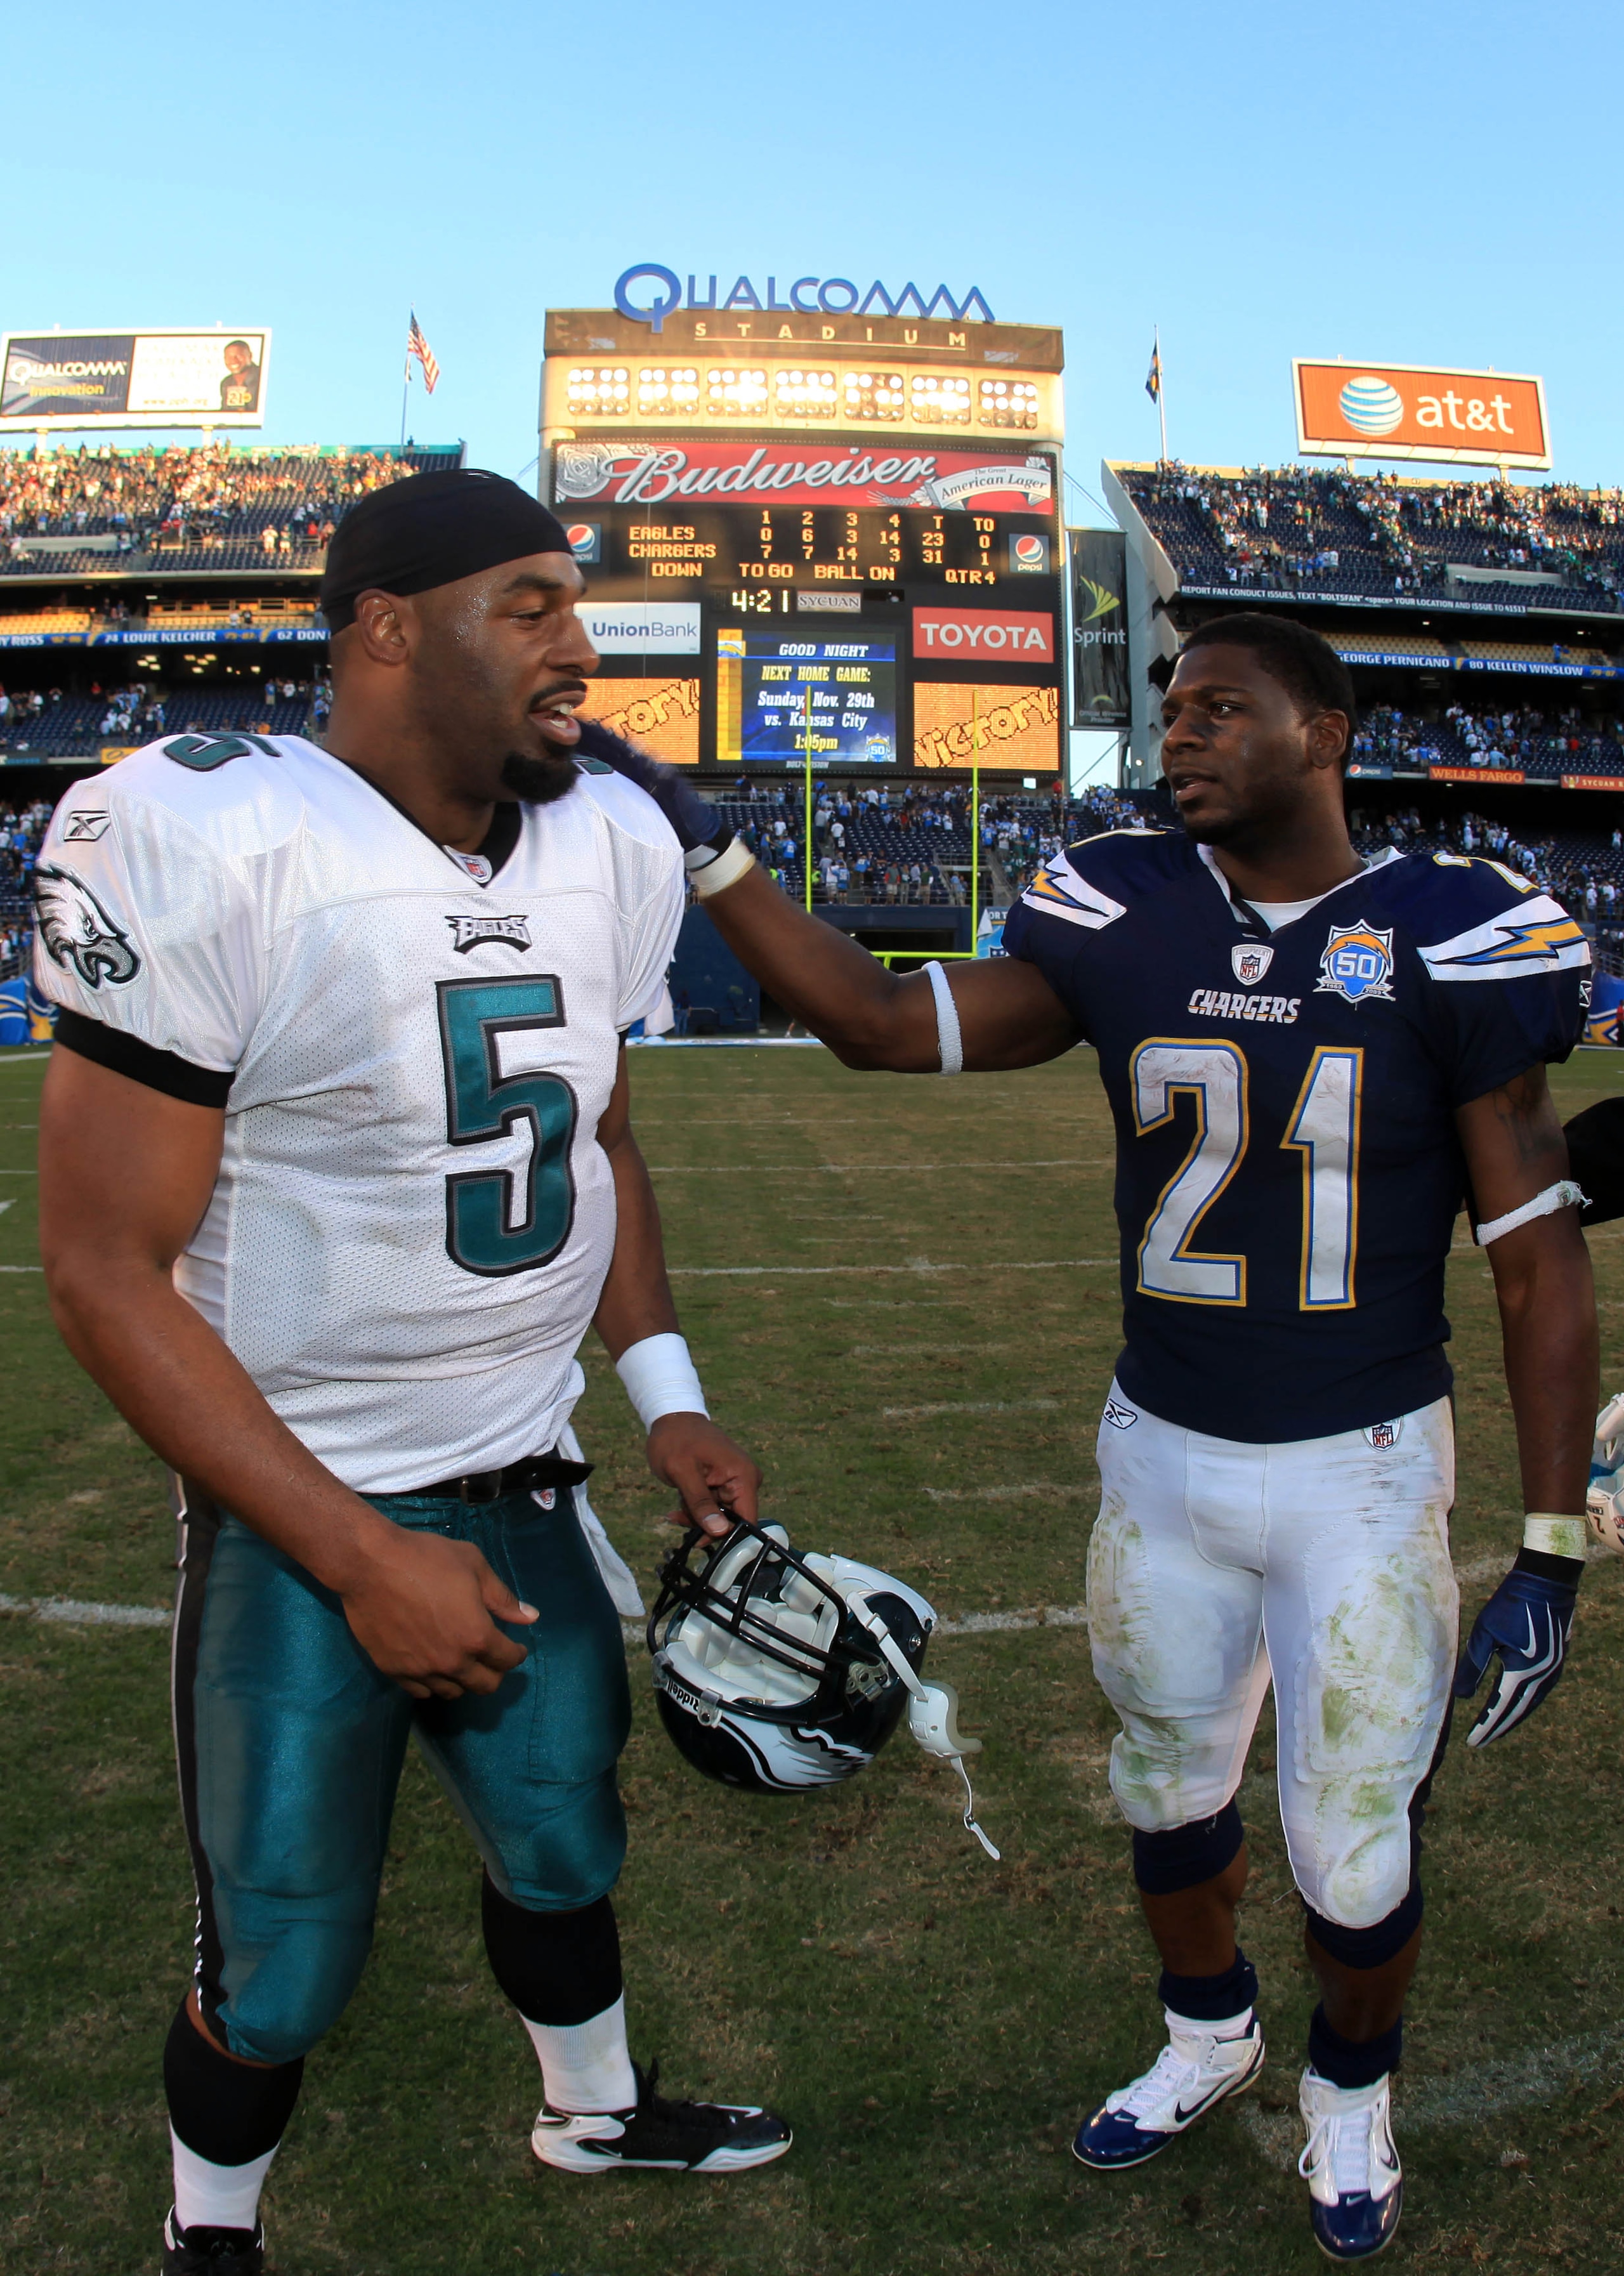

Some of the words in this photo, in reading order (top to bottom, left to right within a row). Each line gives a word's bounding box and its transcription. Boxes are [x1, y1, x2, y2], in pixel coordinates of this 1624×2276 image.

[614, 263, 995, 333] QUALCOMM
[694, 322, 966, 347] STADIUM
[9, 360, 126, 386] QUALCOMM
[30, 383, 104, 397] Innovation
[1415, 390, 1514, 435] at&t
[602, 447, 937, 503] Budweiser
[941, 476, 1004, 500] American
[1007, 473, 1047, 489] Lager
[763, 510, 770, 524] 1
[802, 511, 813, 525] 2
[847, 513, 858, 526] 3
[889, 514, 900, 528] 4
[933, 516, 944, 530] T
[973, 517, 995, 532] TO
[629, 526, 695, 540] EAGLES
[761, 528, 772, 542] 0
[802, 528, 813, 542] 6
[847, 529, 858, 543] 3
[880, 531, 900, 545] 14
[922, 532, 944, 546] 23
[979, 534, 990, 549] 0
[629, 544, 717, 558] CHARGERS
[761, 544, 772, 559] 7
[802, 546, 813, 559] 7
[837, 547, 858, 561] 14
[889, 548, 901, 563] 3
[922, 550, 943, 564] 31
[981, 552, 989, 566] 1
[652, 563, 702, 577] DOWN
[815, 565, 863, 580] BALL
[869, 566, 894, 581] ON
[945, 569, 981, 584] QTR
[984, 571, 995, 584] 4
[1018, 563, 1043, 572] pepsi
[731, 589, 790, 613] 4:21
[797, 595, 860, 608] SYCUAN
[1181, 585, 1210, 595] REPORT
[1212, 587, 1228, 596] FAN
[1229, 587, 1266, 598] CONDUCT
[1267, 589, 1296, 600] ISSUES,
[1297, 592, 1316, 600] TEXT
[1395, 597, 1415, 606] YOUR
[1417, 598, 1453, 609] LOCATION
[1455, 600, 1470, 610] AND
[1472, 602, 1493, 612] ISSUE
[1494, 603, 1504, 612] TO
[123, 633, 159, 643] LOUIE
[161, 631, 216, 643] KELCHER
[277, 631, 292, 640] 62
[297, 630, 325, 641] DON
[593, 622, 697, 637] UnionBank
[920, 622, 1047, 650] TOYOTA
[1074, 627, 1126, 648] Sprint
[11, 634, 44, 646] ROSS
[779, 643, 816, 657] GOOD
[823, 644, 868, 657] NIGHT
[1384, 655, 1450, 667] PERNICANO
[1469, 660, 1484, 670] 80
[1487, 661, 1528, 672] KELLEN
[1530, 664, 1583, 676] WINSLOW
[761, 665, 792, 681] NEXT
[797, 666, 830, 681] HOME
[836, 667, 871, 682] GAME:
[757, 691, 805, 710] Sunday,
[813, 692, 839, 707] Nov.
[846, 693, 875, 708] 29th
[764, 714, 782, 726] vs.
[789, 712, 834, 727] Kansas
[842, 712, 868, 731] City
[794, 734, 838, 753] 1:05pm
[1431, 767, 1477, 780] WELLS
[1480, 769, 1522, 782] FARGO
[1582, 778, 1614, 787] SYCUAN
[445, 915, 532, 954] EAGLES
[1241, 964, 1257, 978] NFL
[1336, 952, 1377, 979] 50
[1188, 988, 1301, 1024] CHARGERS
[435, 974, 577, 1278] 5
[1130, 1037, 1364, 1311] 21
[1375, 1433, 1392, 1446] NFL
